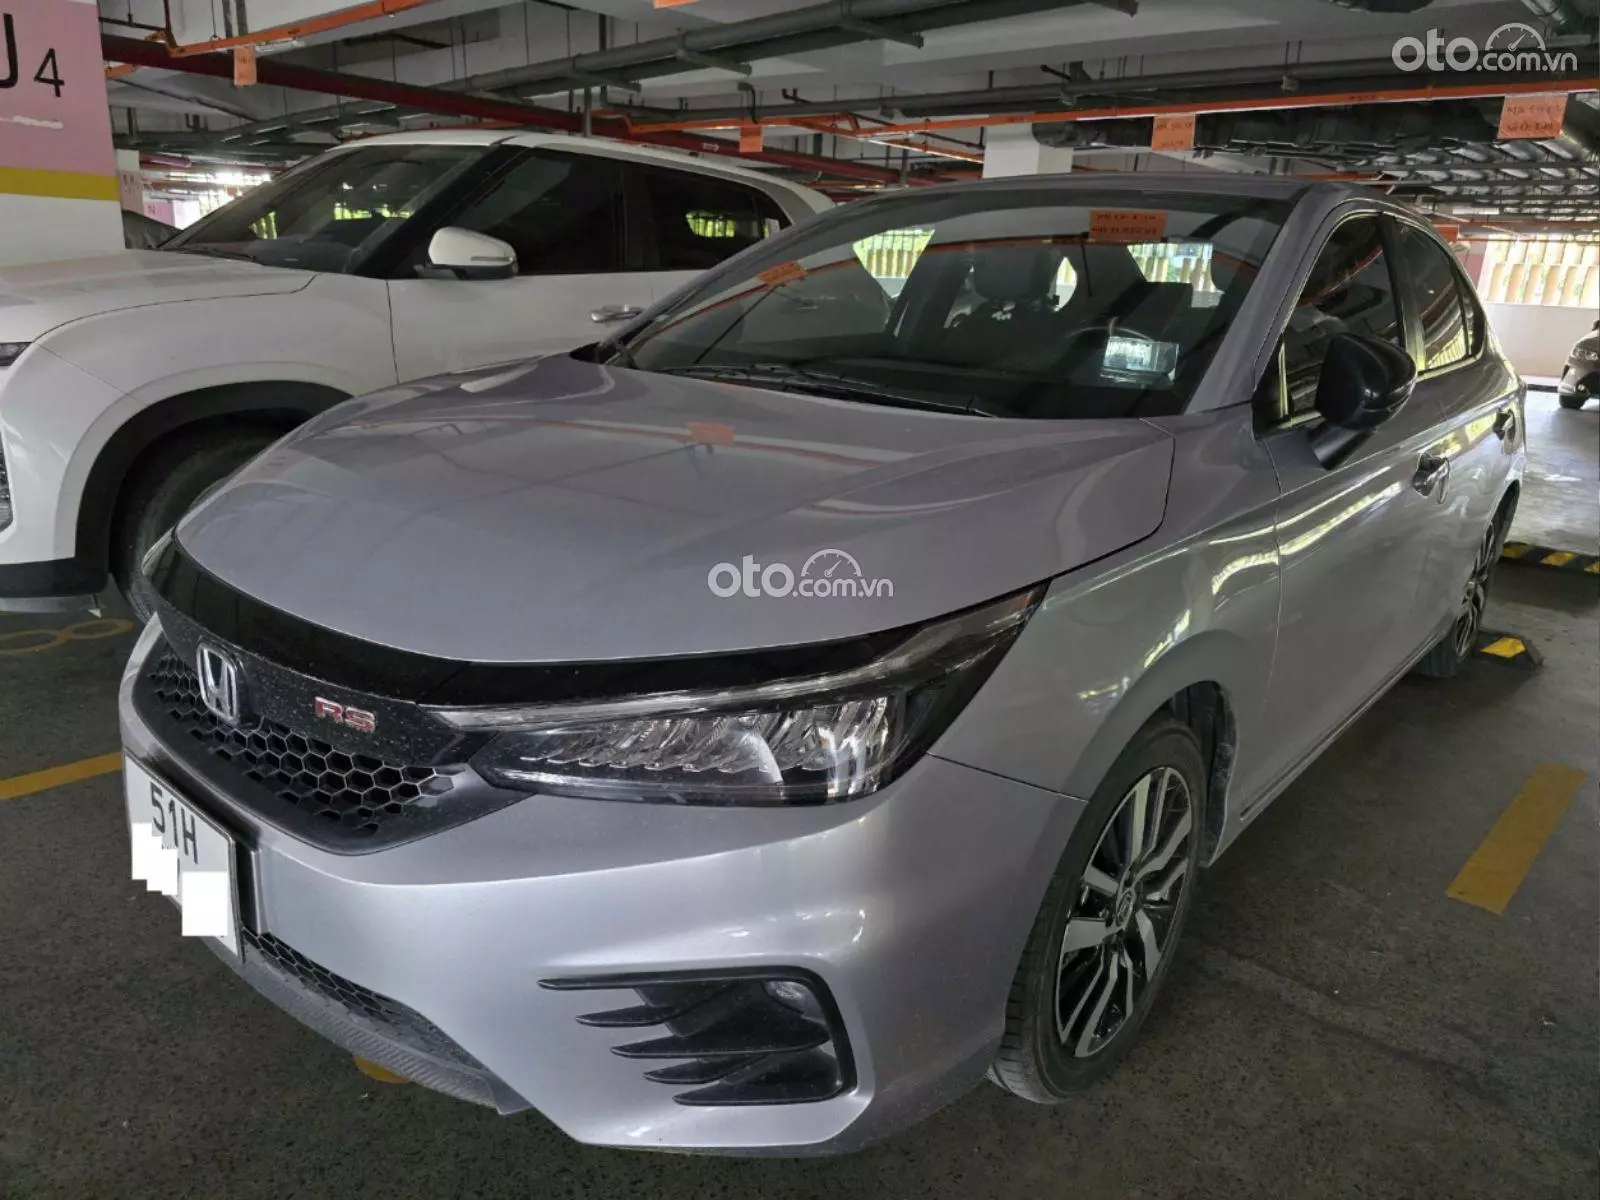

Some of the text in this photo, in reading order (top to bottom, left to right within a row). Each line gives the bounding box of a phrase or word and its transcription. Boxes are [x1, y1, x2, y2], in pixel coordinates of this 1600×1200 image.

[33, 47, 65, 98] 4
[315, 696, 375, 733] RS
[151, 782, 199, 865] 51H
